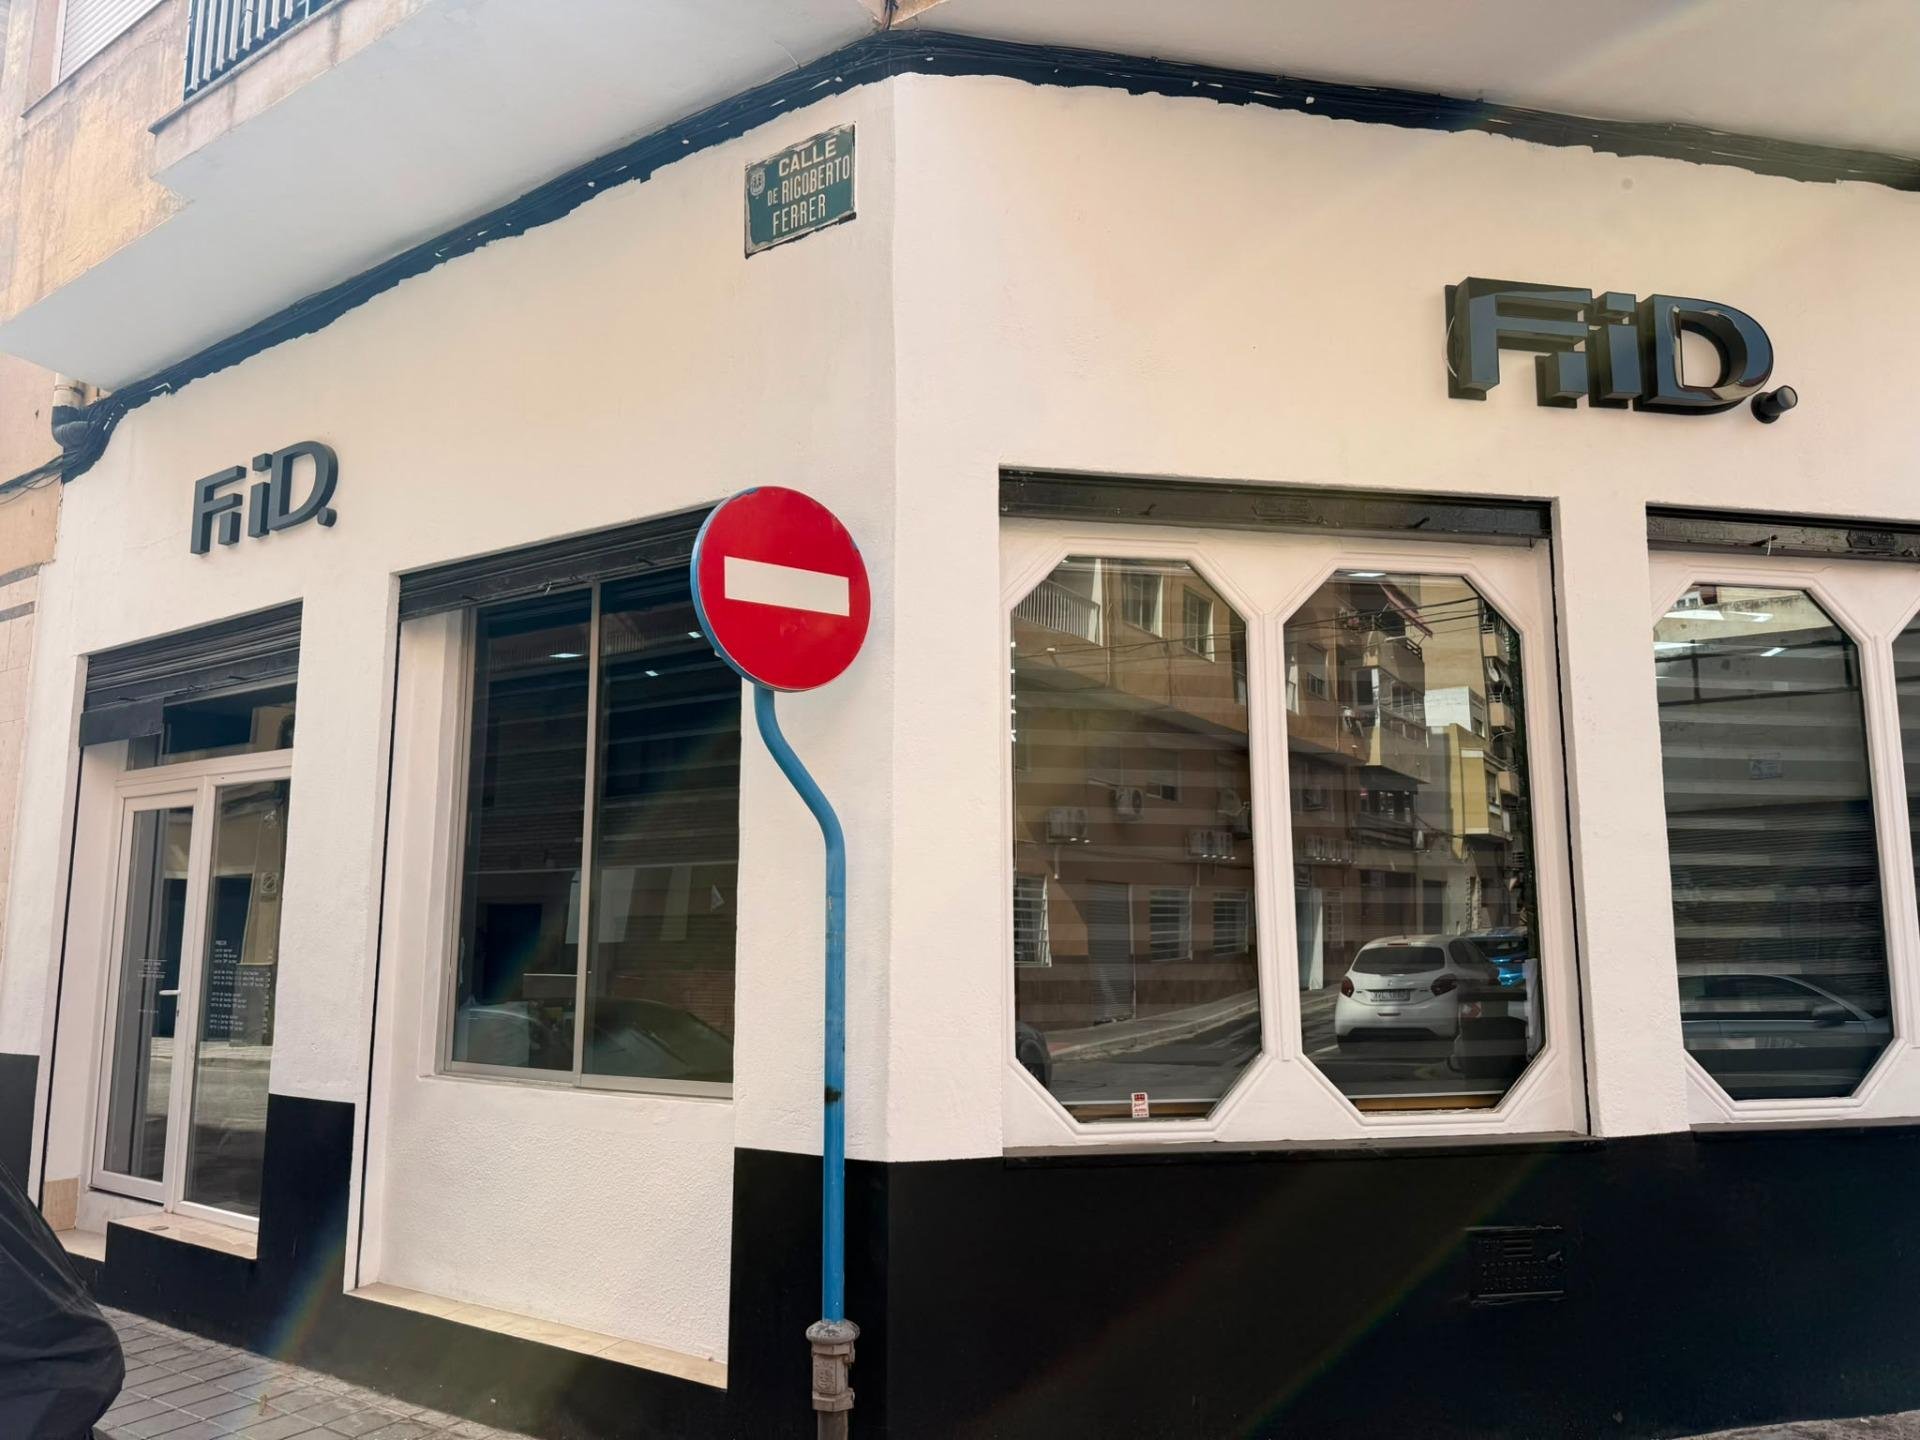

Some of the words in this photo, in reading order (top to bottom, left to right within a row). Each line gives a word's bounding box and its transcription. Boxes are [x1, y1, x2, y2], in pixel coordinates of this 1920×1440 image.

[778, 138, 837, 177] CALLE
[767, 187, 779, 206] DE
[772, 194, 826, 236] FERRER
